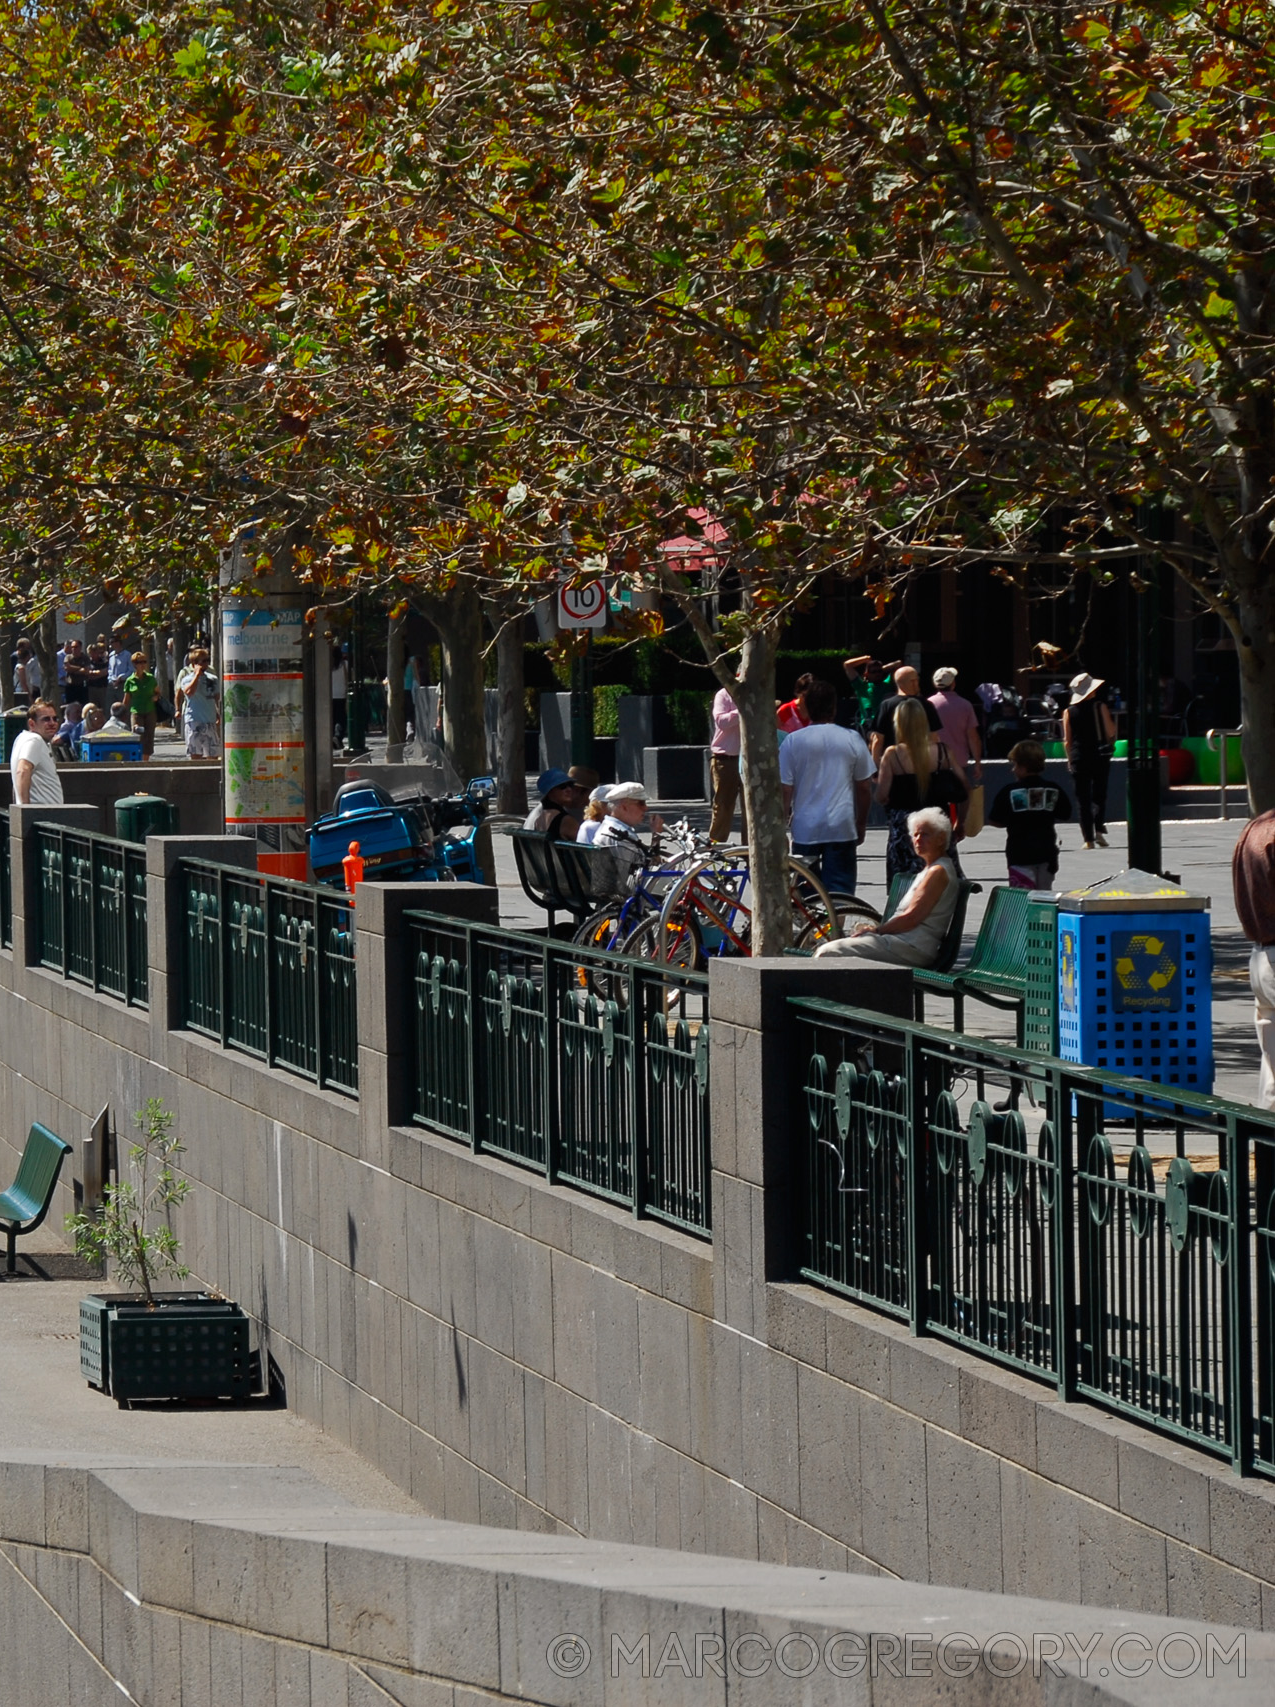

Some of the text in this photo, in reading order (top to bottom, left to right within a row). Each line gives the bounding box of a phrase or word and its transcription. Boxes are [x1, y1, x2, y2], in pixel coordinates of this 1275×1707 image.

[574, 587, 595, 608] 10
[228, 631, 289, 646] melbourne
[1123, 996, 1172, 1007] Recycling
